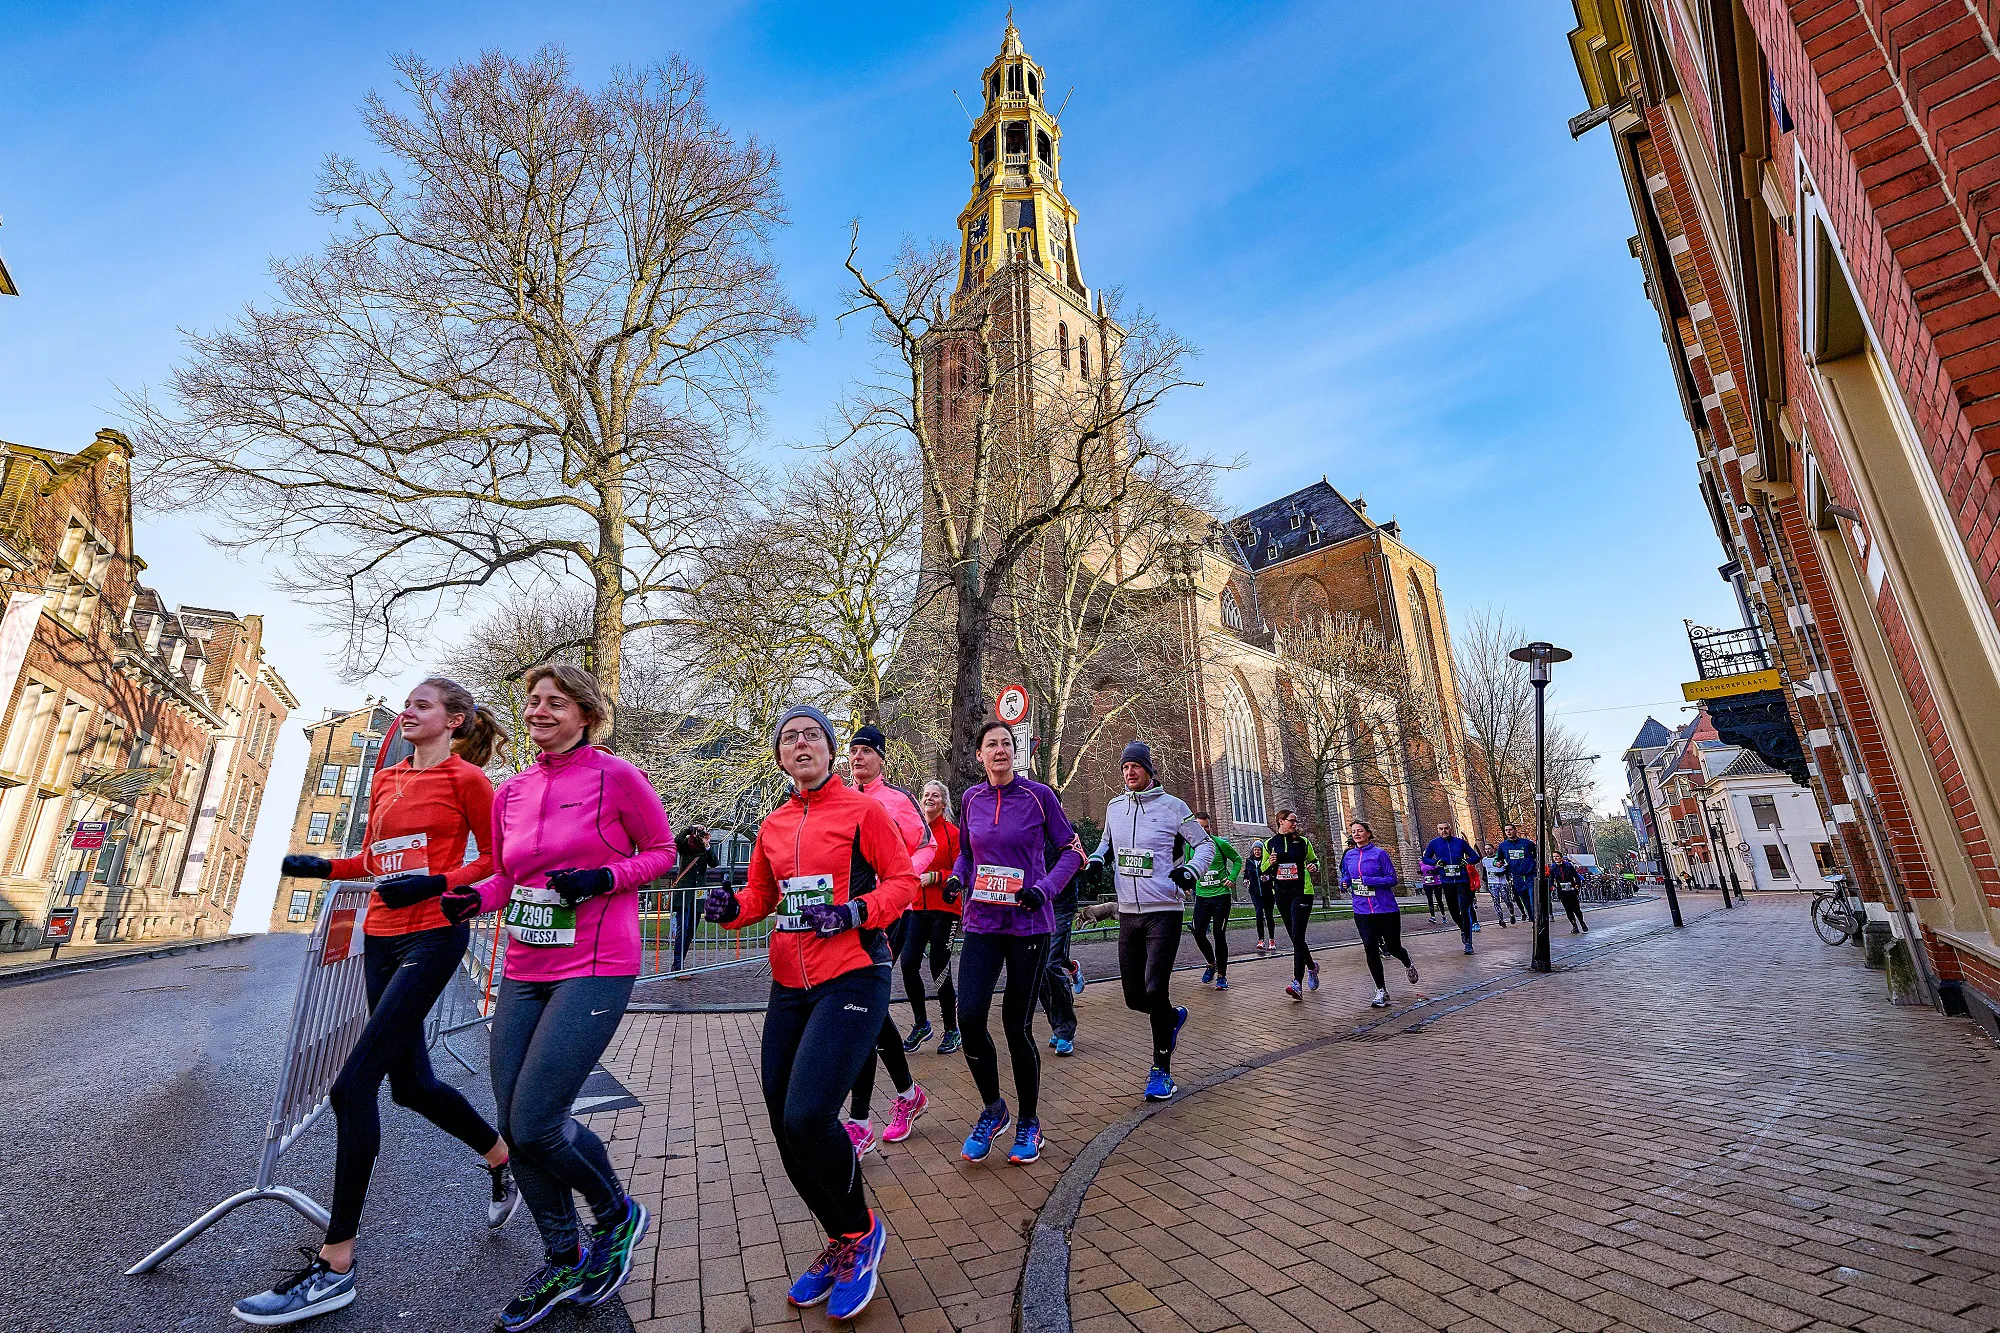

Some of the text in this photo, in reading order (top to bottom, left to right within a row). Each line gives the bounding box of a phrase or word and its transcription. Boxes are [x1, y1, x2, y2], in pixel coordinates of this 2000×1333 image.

[1690, 678, 1768, 693] STADSWERKPLAATS
[381, 852, 404, 872] 1417
[1125, 856, 1143, 868] 3260
[986, 876, 1008, 892] 2791
[521, 904, 554, 928] 2396
[520, 928, 558, 943] VANESSA
